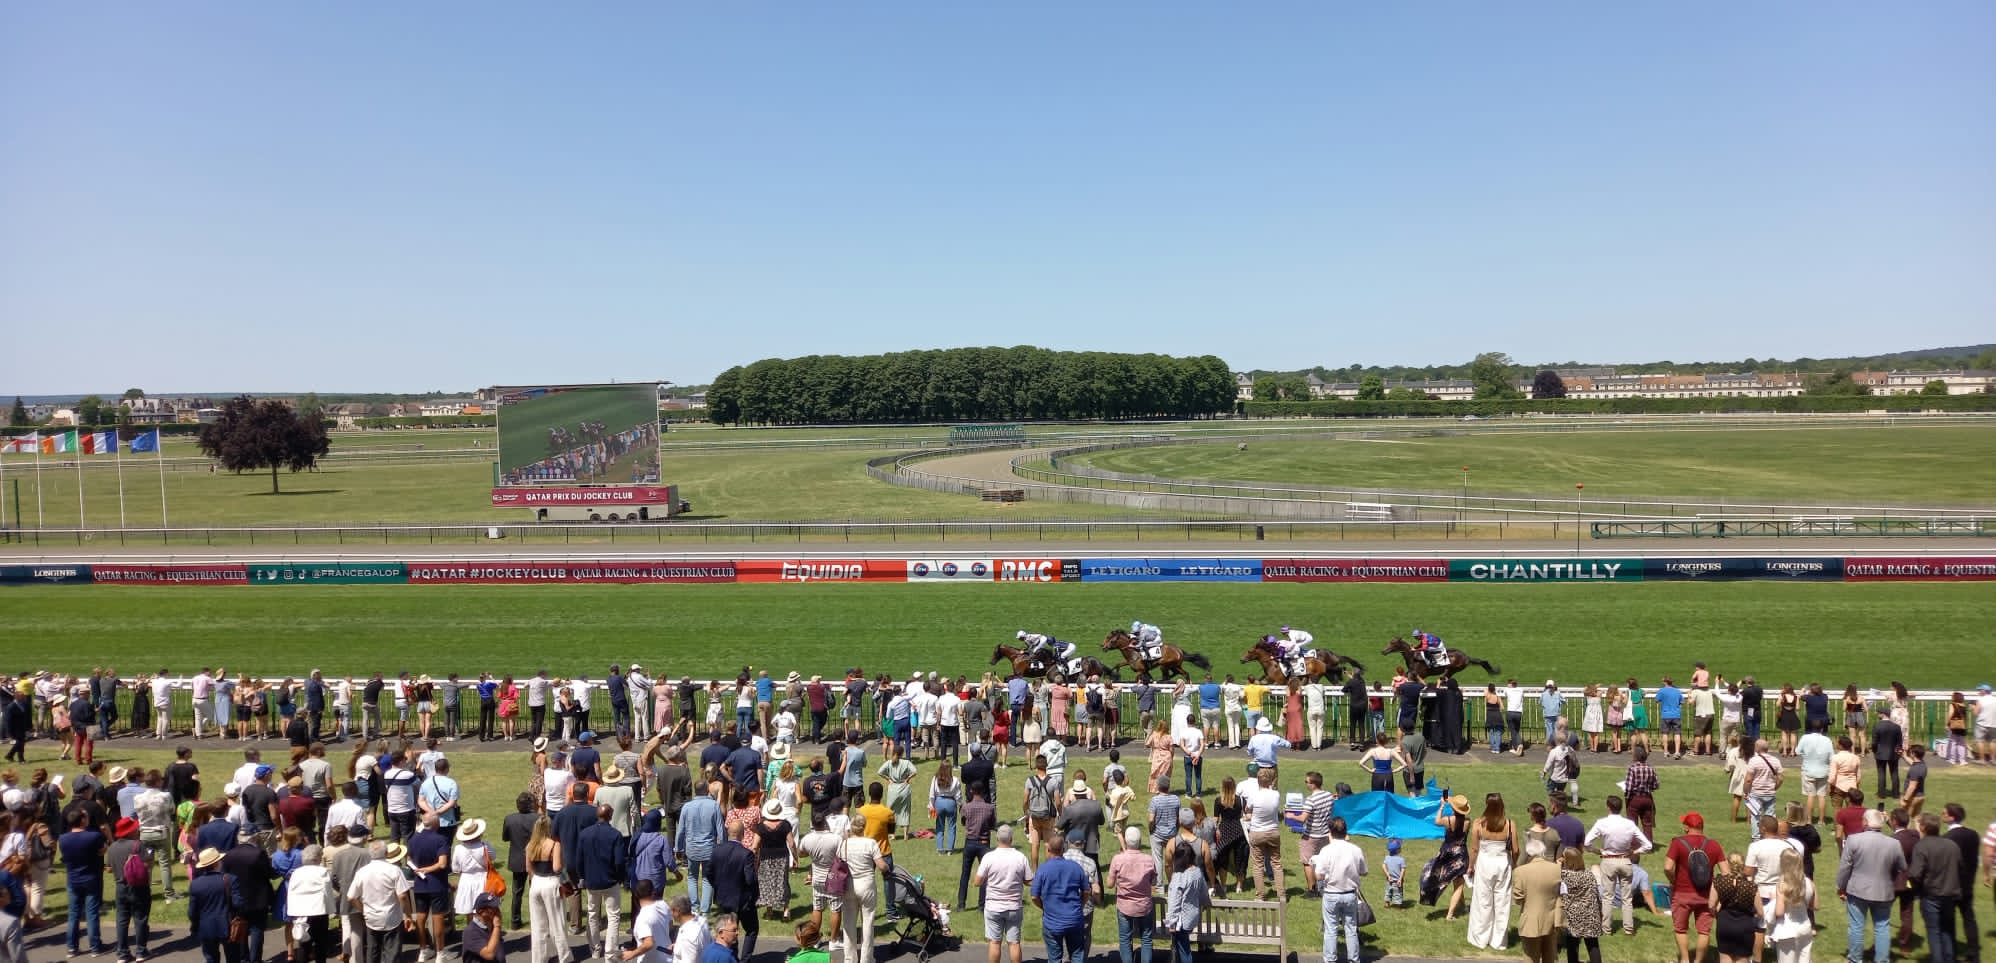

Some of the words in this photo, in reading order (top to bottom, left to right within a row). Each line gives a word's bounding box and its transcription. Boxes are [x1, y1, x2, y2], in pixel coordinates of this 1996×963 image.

[526, 493, 551, 501] QATAR
[553, 493, 570, 501] PRIX
[781, 562, 863, 582] EQUIDIA
[1001, 561, 1053, 581] RMC
[1264, 567, 1296, 577] QATAR
[1300, 567, 1339, 577] RACING
[1352, 566, 1416, 578] EQUESTRIAN
[1419, 566, 1446, 576] CLUB
[1470, 563, 1622, 579] CHANTILLY
[1666, 563, 1722, 572] LONGINES
[1766, 562, 1823, 571] LONGINES
[1847, 564, 1883, 576] QATAR
[1887, 564, 1930, 575] RACING
[1933, 567, 1940, 575] &
[34, 569, 76, 577] LONGINES
[94, 571, 121, 581] QATAR
[124, 571, 157, 581] RACING
[166, 571, 222, 581] EQUESTRIAN
[223, 570, 247, 580] CLUB
[312, 568, 400, 579] @FRANCEGALOP
[411, 568, 467, 579] #QATAR
[470, 568, 567, 579] #JOCKEYCLUB
[572, 568, 602, 579] QATAR
[604, 568, 640, 578] RACING
[651, 567, 708, 579] EQUESTRIAN
[711, 567, 735, 578] CLUB
